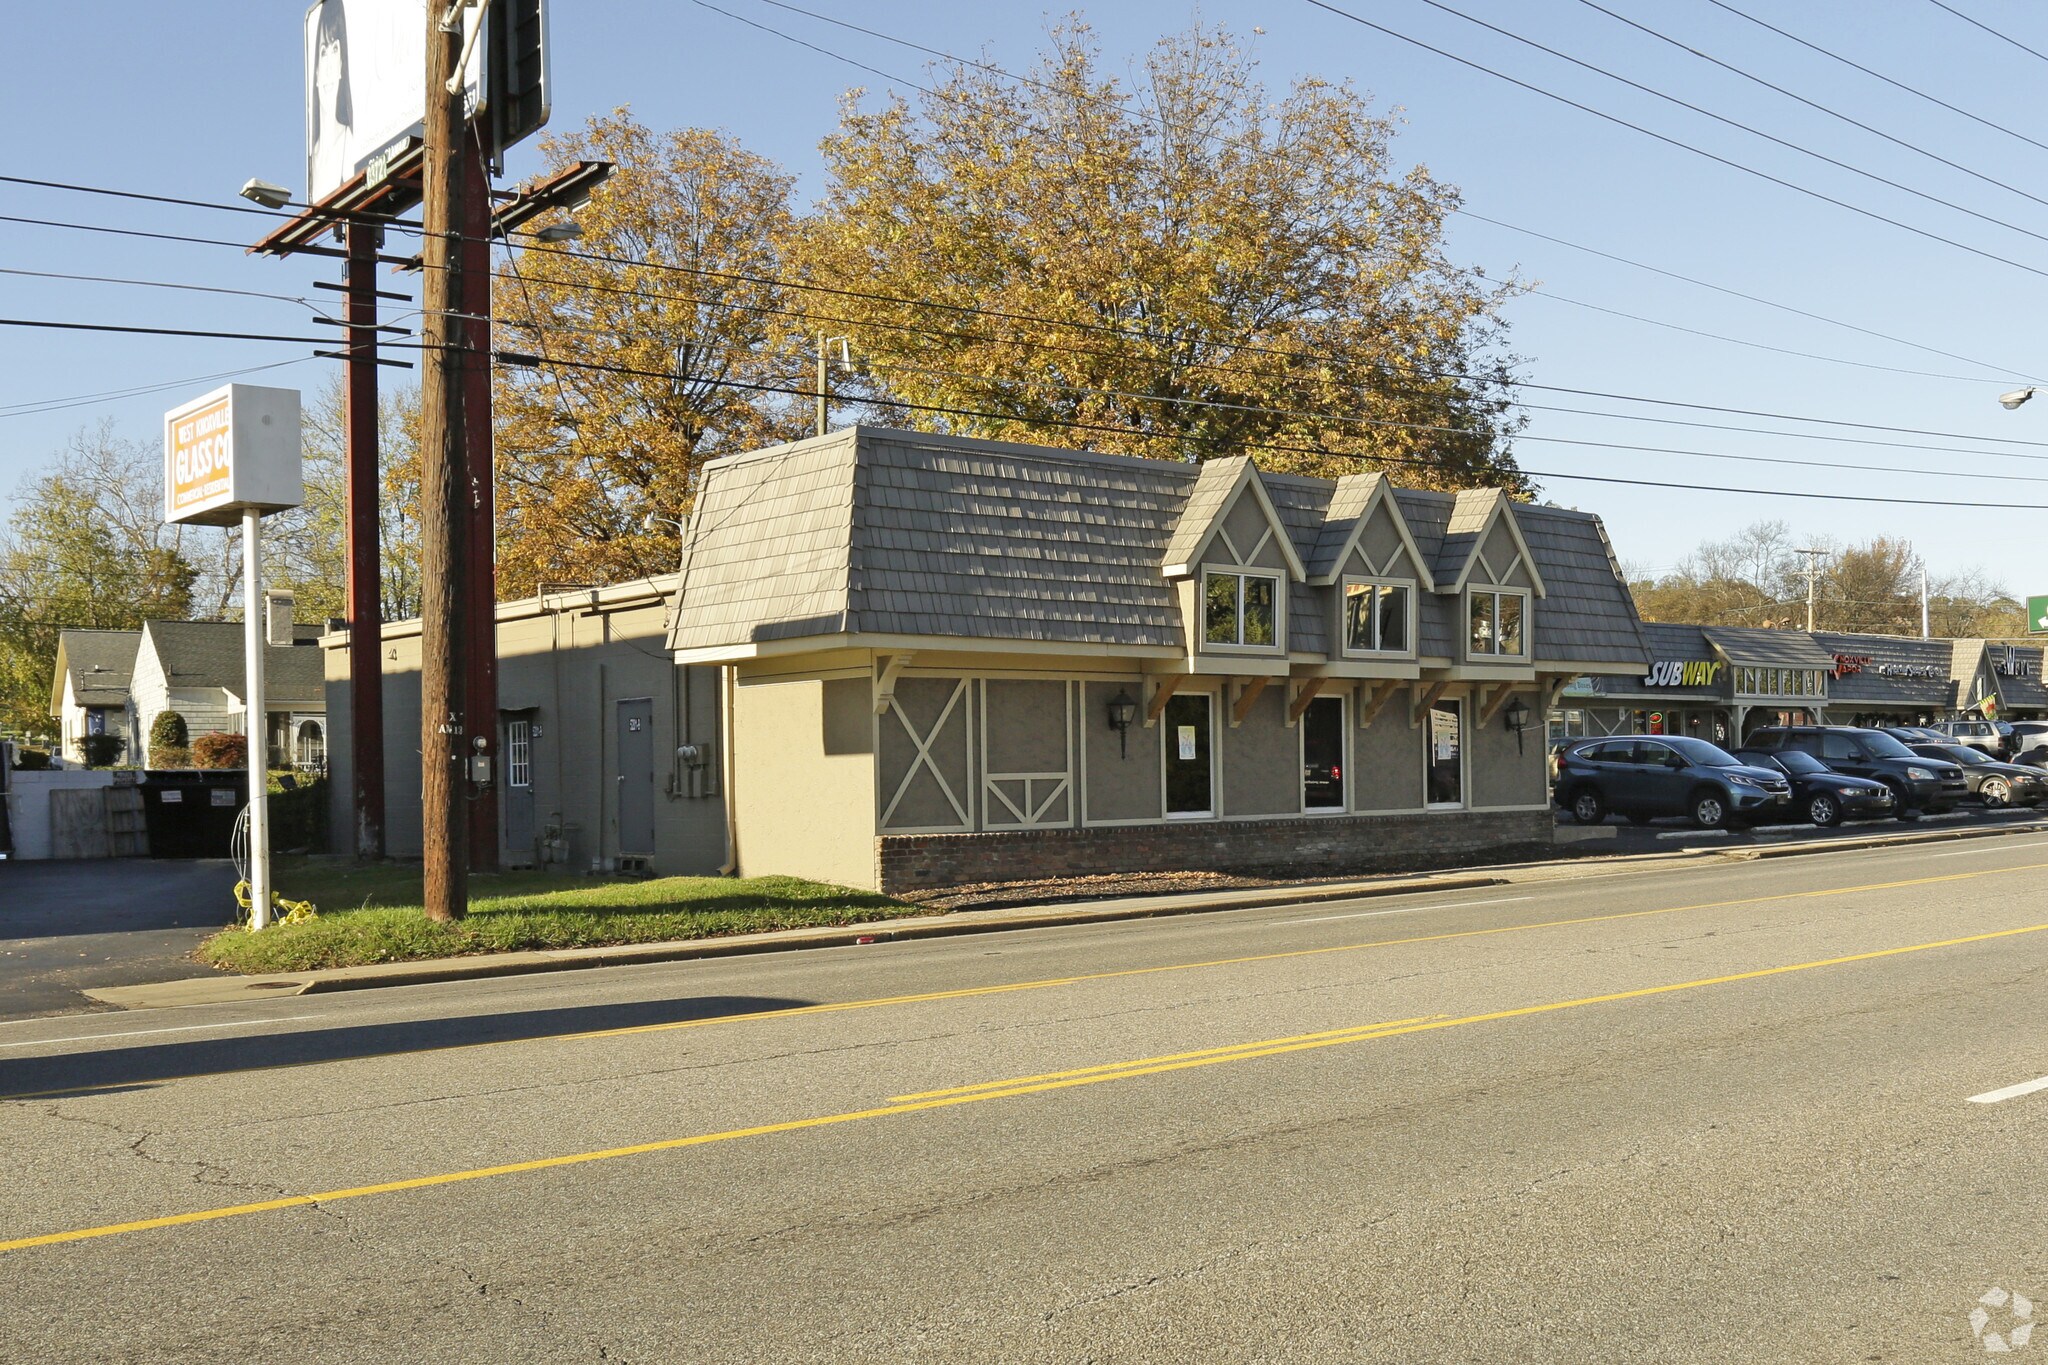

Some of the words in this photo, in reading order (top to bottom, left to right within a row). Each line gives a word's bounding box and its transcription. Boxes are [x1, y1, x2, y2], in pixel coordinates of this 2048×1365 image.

[179, 422, 194, 444] WEST
[176, 438, 212, 485] GLASS
[1644, 660, 1721, 687] SUBWAY
